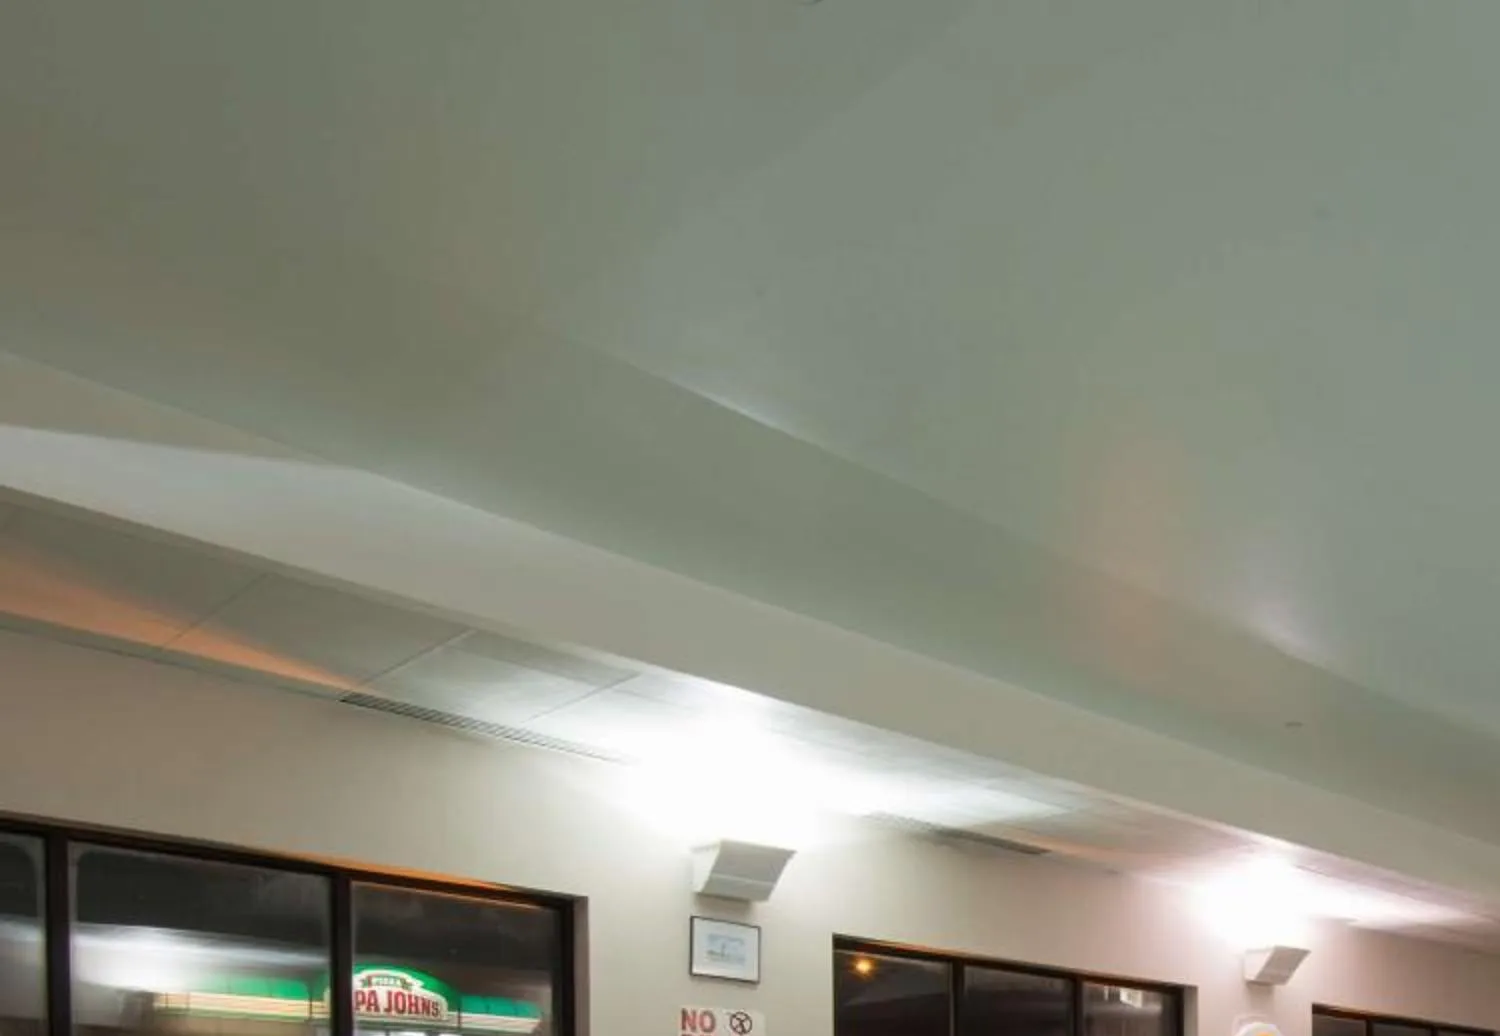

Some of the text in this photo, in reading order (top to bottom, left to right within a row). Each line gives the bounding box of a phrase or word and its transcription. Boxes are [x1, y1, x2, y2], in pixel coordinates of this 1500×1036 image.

[354, 989, 440, 1017] PA JOHNS
[681, 1008, 716, 1033] NO
